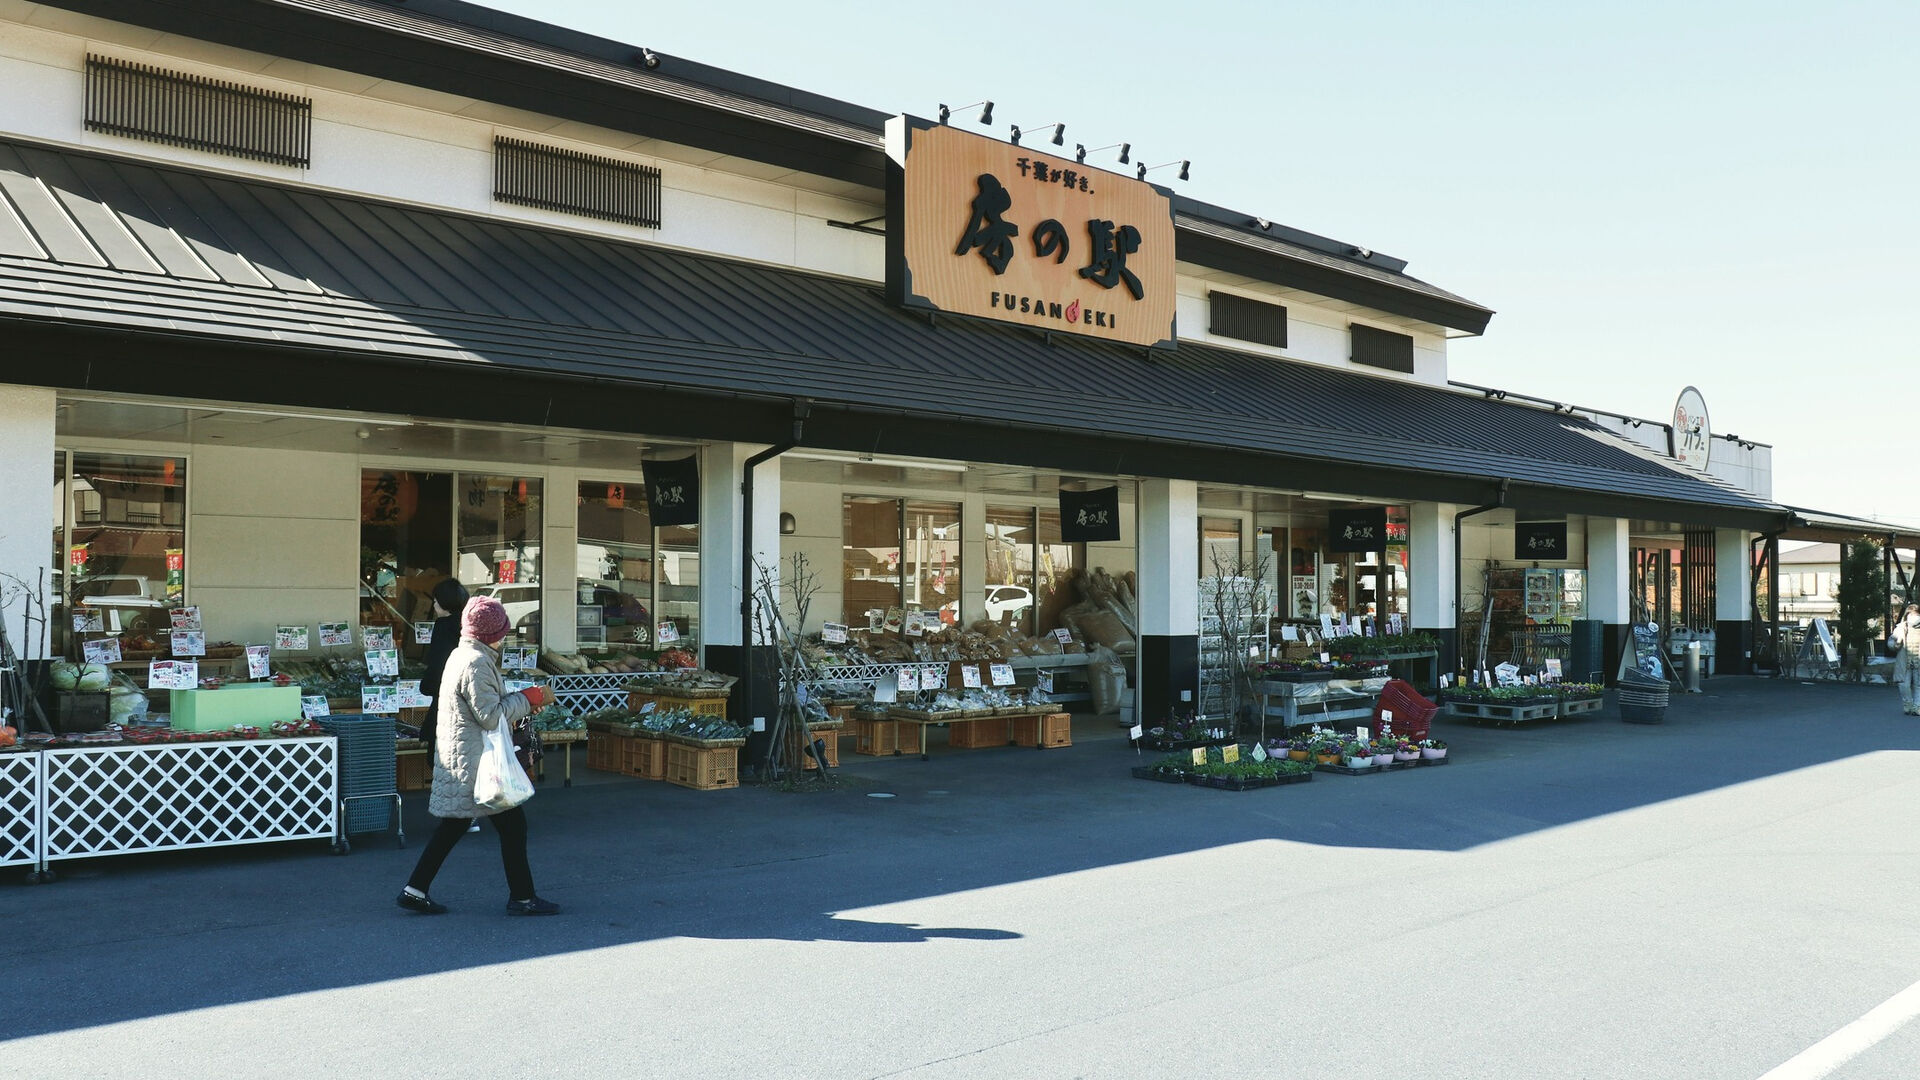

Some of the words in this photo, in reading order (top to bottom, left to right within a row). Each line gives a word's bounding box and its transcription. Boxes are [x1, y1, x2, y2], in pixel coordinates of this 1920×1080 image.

[954, 173, 1145, 301] 房の駅
[1076, 508, 1109, 526] 房の駅
[1343, 526, 1374, 540] 房の駅
[1528, 536, 1556, 549] 房の駅
